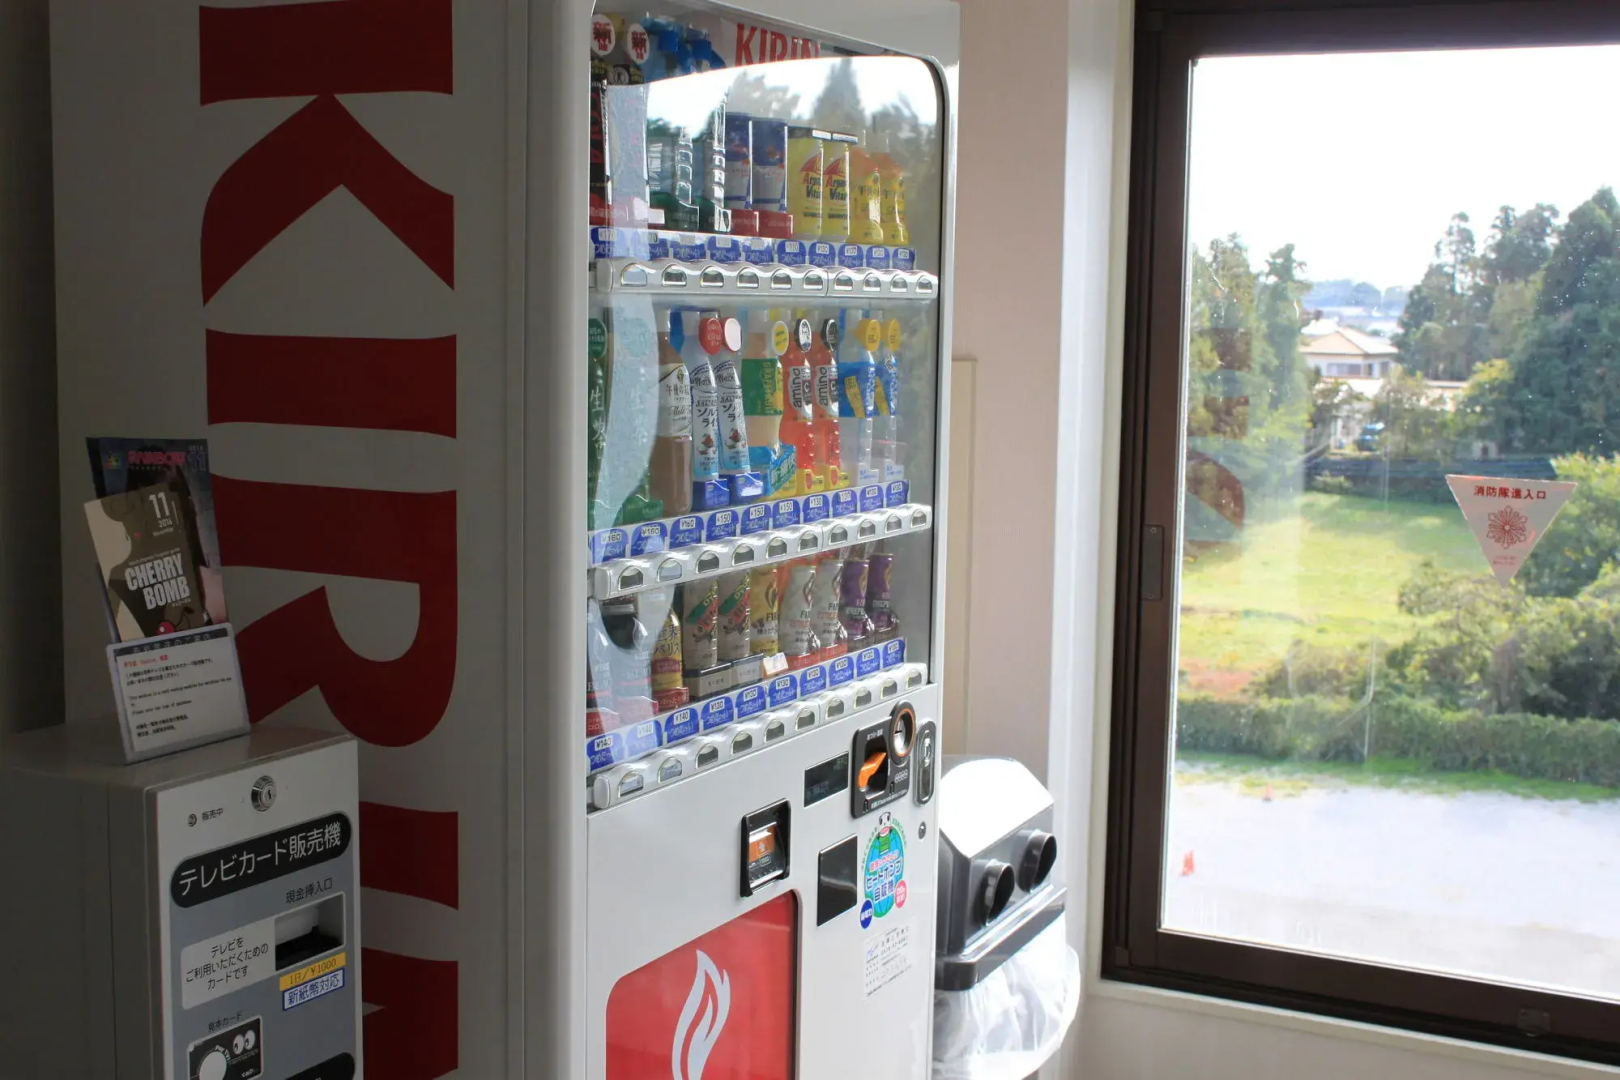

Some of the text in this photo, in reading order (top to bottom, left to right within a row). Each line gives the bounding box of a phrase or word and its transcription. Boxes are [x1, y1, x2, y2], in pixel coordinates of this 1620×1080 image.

[793, 368, 803, 408] amino
[818, 367, 829, 406] amino
[128, 451, 186, 465] RAINBOW
[149, 492, 171, 519] 11
[1473, 485, 1547, 500] 消防隊進入口
[158, 518, 173, 529] 2016
[200, 0, 457, 1080] KIR
[124, 553, 185, 591] CHERRY
[142, 576, 190, 611] BOMB
[201, 808, 224, 821] 販売中
[179, 821, 342, 897] テレビカード販売機
[866, 860, 903, 890] ヒートポンプ
[285, 878, 333, 904] 現金挿入口
[875, 880, 894, 902] 自販機
[210, 937, 244, 958] テレビを
[185, 943, 269, 983] ご利用いただくための
[207, 965, 249, 990] カードです
[287, 974, 340, 1006] 新紙幣対応
[207, 1011, 243, 1033] 見本カード
